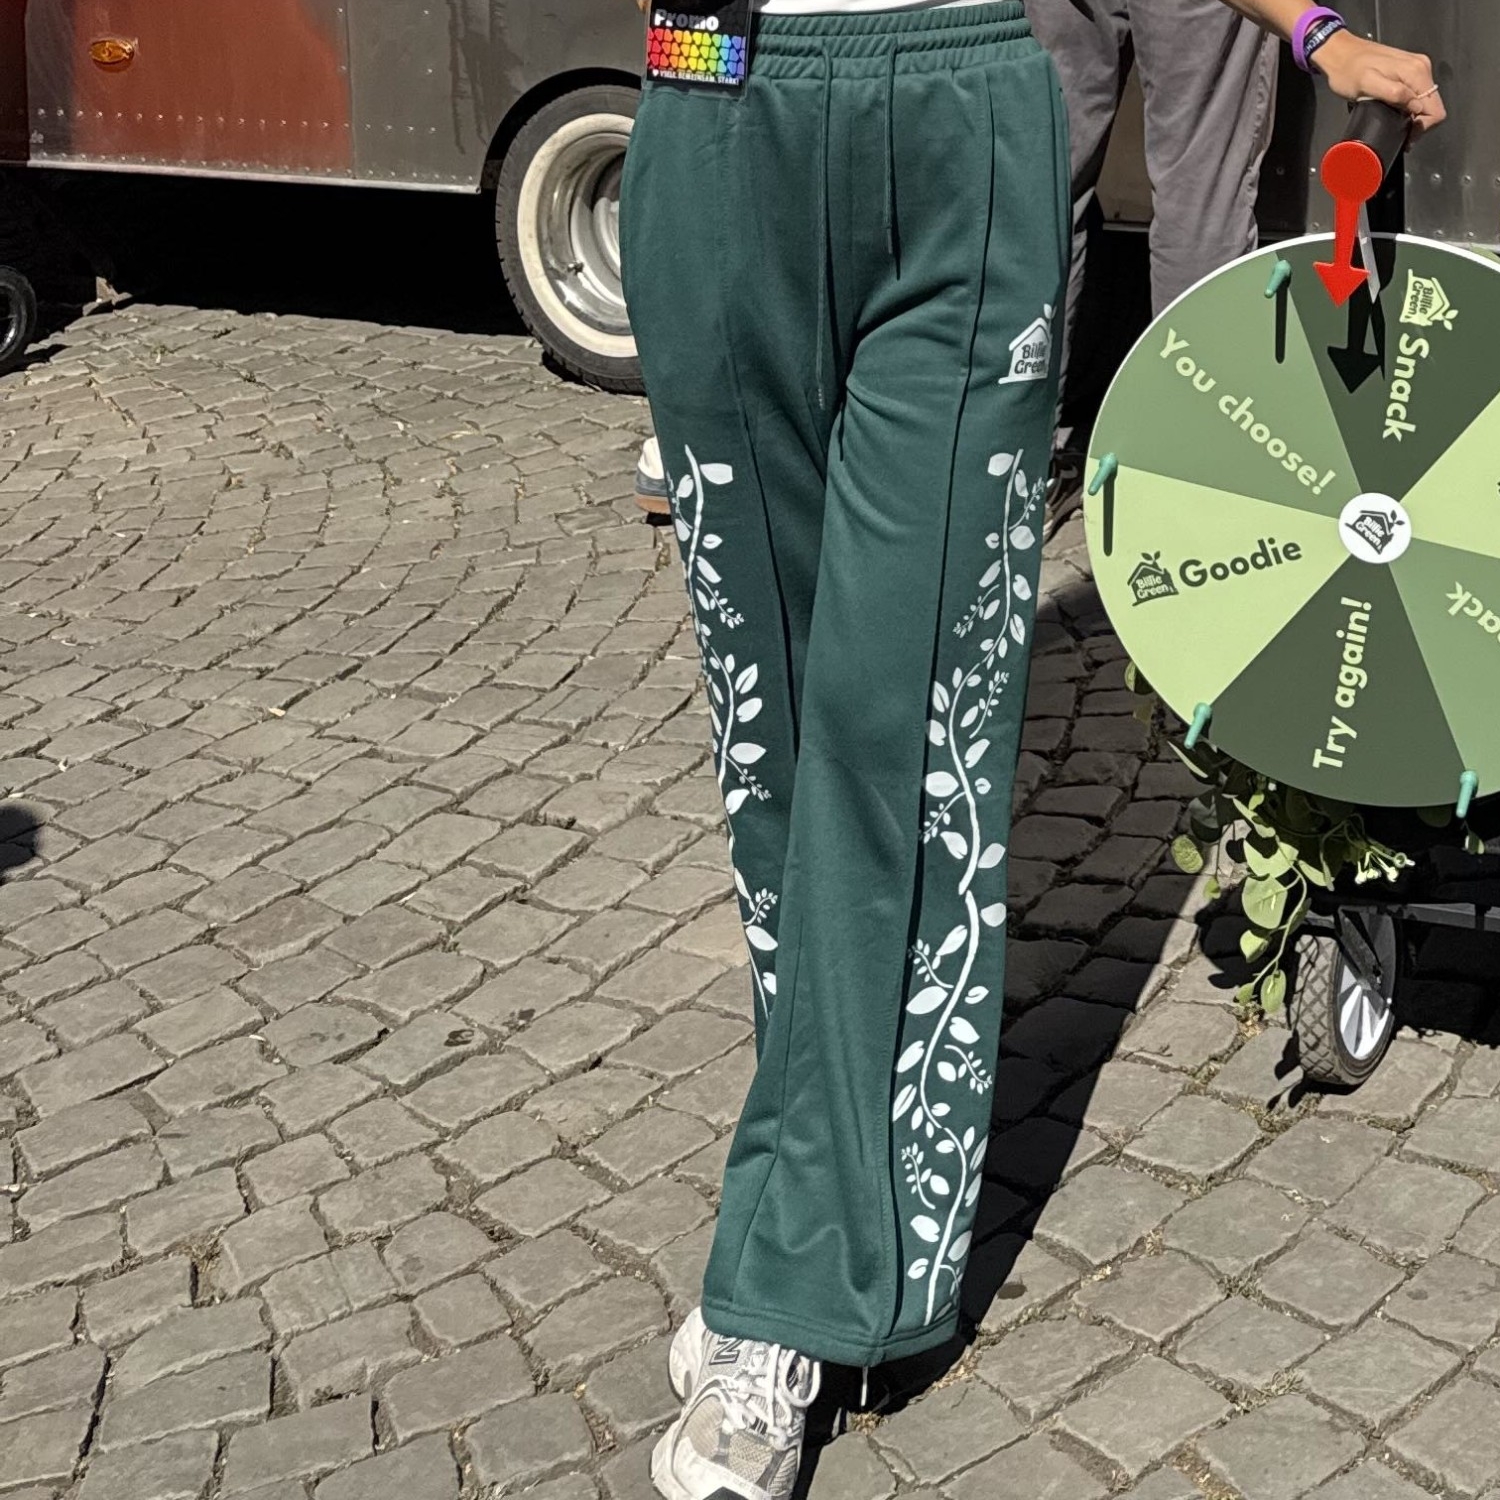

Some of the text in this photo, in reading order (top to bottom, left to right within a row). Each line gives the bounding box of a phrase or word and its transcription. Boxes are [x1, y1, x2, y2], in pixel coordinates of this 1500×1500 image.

[654, 8, 719, 31] Promo
[1407, 280, 1424, 315] Green
[1419, 286, 1434, 315] Billie
[1382, 333, 1430, 441] Snack
[1156, 327, 1336, 495] You choose!
[1355, 521, 1381, 546] Green
[1363, 516, 1385, 537] Billie
[1179, 537, 1302, 587] Goodie
[1136, 574, 1163, 590] Billie
[1136, 583, 1169, 599] Green
[1312, 597, 1372, 770] Try again!
